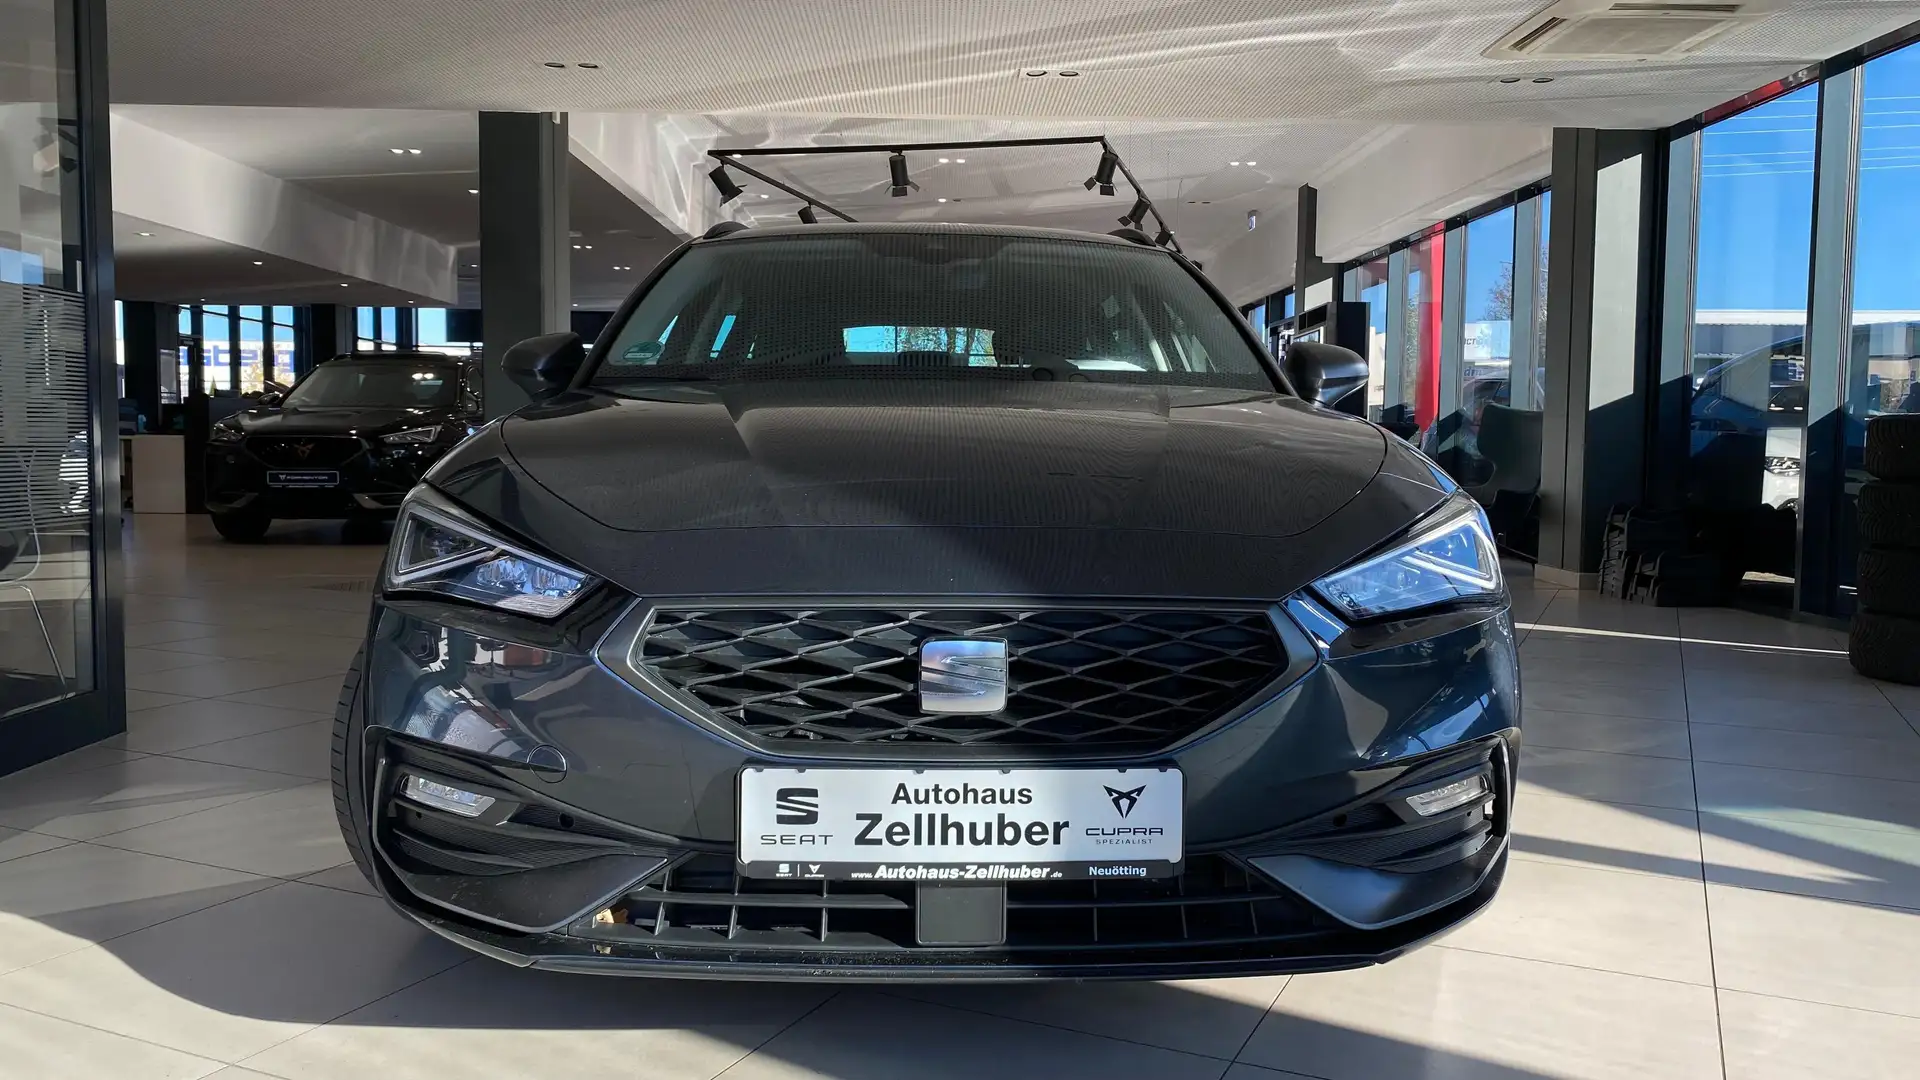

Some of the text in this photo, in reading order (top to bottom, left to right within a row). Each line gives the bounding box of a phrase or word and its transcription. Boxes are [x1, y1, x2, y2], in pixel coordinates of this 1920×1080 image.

[891, 782, 1033, 805] Autohaus
[854, 813, 1070, 846] Zellhuber
[1085, 827, 1164, 836] CUPRA
[760, 834, 833, 845] SEAT
[1088, 865, 1147, 877] Neuötting
